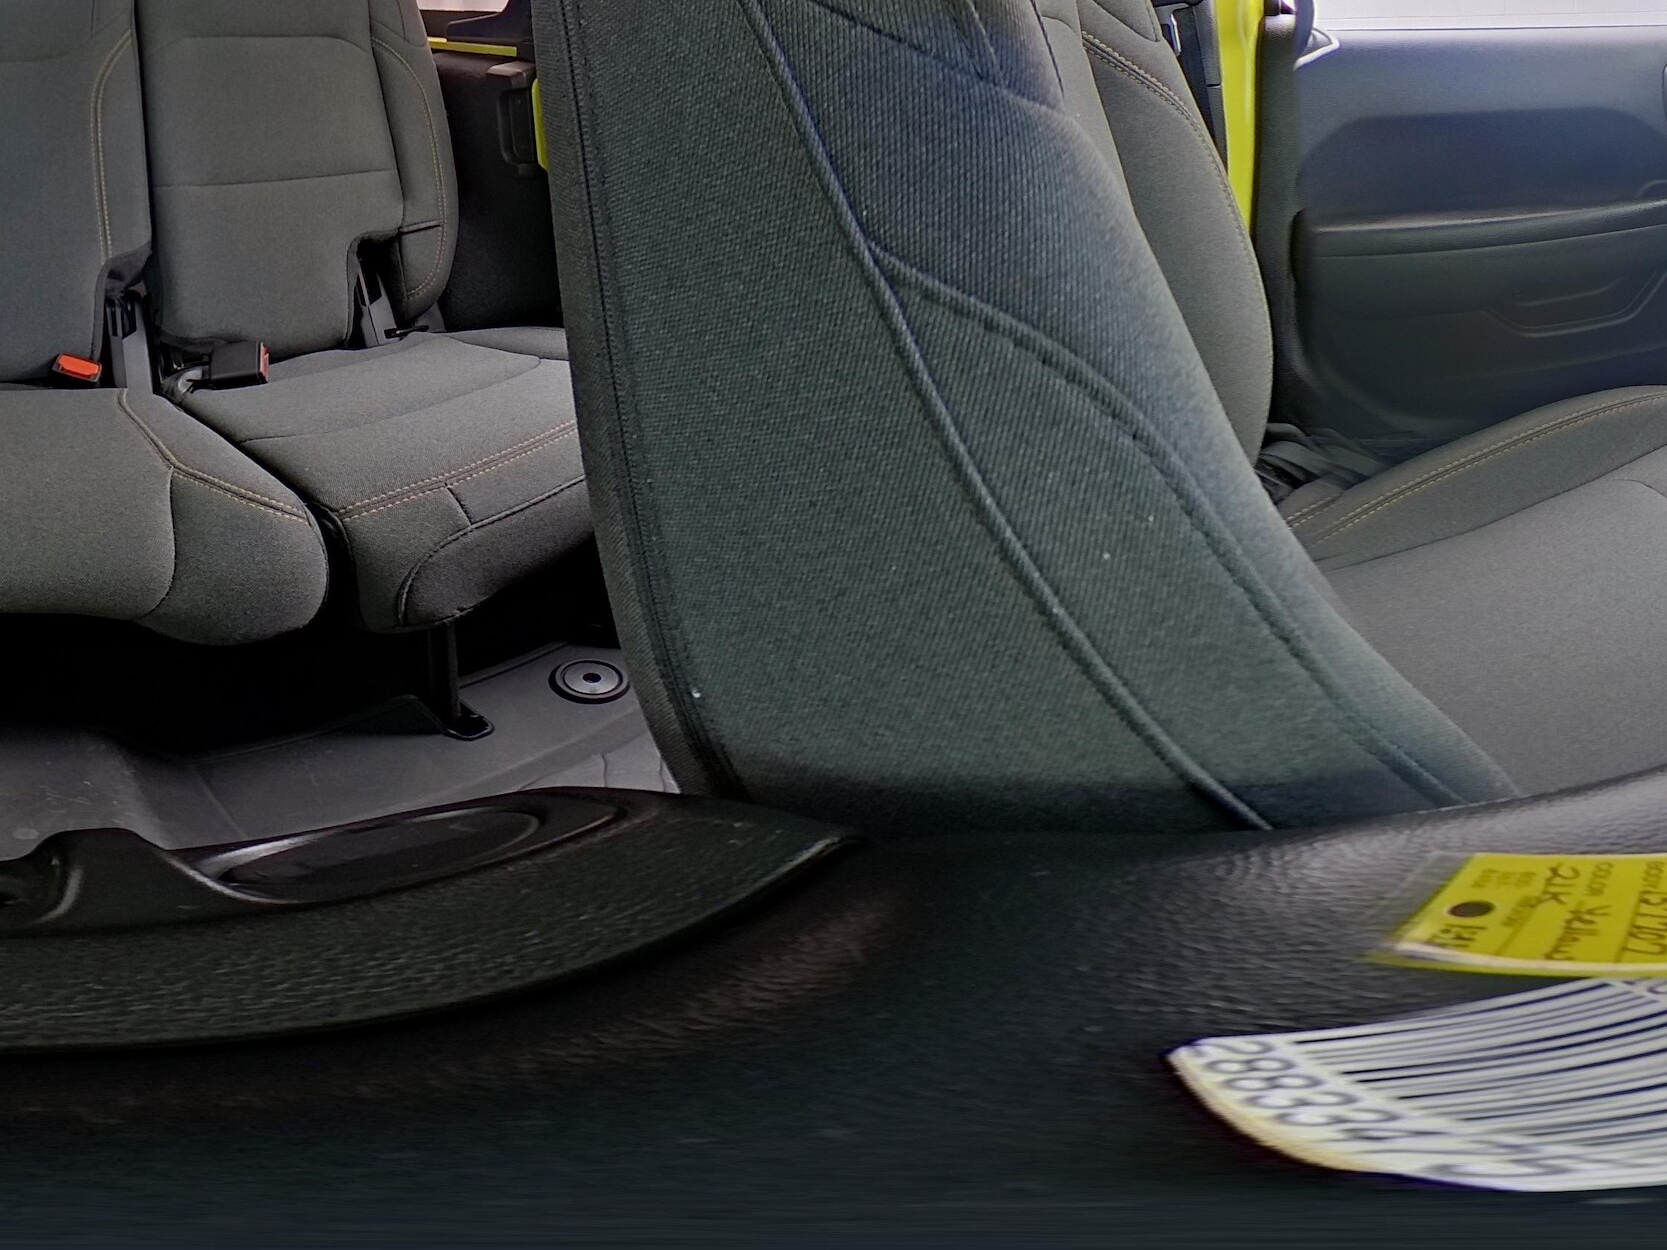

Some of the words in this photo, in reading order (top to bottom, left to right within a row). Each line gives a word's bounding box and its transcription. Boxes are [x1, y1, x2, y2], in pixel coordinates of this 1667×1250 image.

[1585, 862, 1615, 896] COLOR
[1641, 860, 1665, 889] BODY
[1203, 1038, 1667, 1182] 28833475
